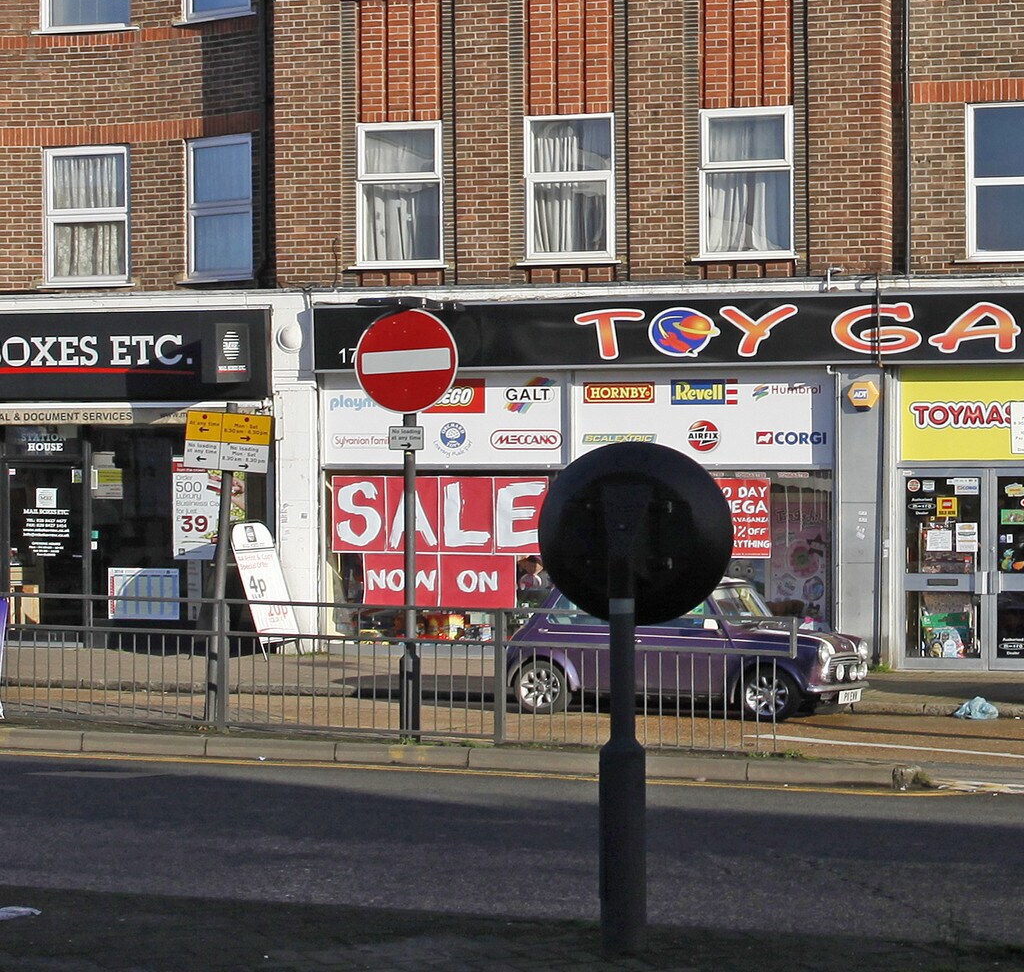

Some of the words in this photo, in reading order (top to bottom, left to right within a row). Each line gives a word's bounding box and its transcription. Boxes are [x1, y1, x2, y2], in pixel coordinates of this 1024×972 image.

[574, 303, 798, 360] TOY
[0, 334, 99, 367] OXES
[109, 334, 193, 366] ETC.
[505, 388, 551, 401] GALT
[590, 387, 648, 399] HORNBY
[675, 382, 723, 401] Revell
[771, 384, 822, 395] Humbrol
[853, 389, 868, 399] ADT
[436, 386, 475, 406] EGO
[329, 394, 377, 411] playm
[13, 412, 21, 421] &
[23, 412, 80, 422] DOCUMENT
[82, 411, 133, 421] SERVICES
[21, 433, 67, 442] STATION
[334, 435, 370, 448] Sylvanian
[494, 434, 558, 445] MECCANO
[584, 433, 653, 443] SCALEXTRIC
[688, 432, 720, 440] AIRFIX
[774, 432, 828, 445] CORGI
[27, 442, 64, 452] HOUSE
[176, 481, 202, 493] 500
[738, 486, 768, 498] DAY
[176, 493, 202, 501] Luxury
[336, 481, 547, 550] SALE
[366, 569, 438, 592] NOW
[456, 570, 499, 593] ON
